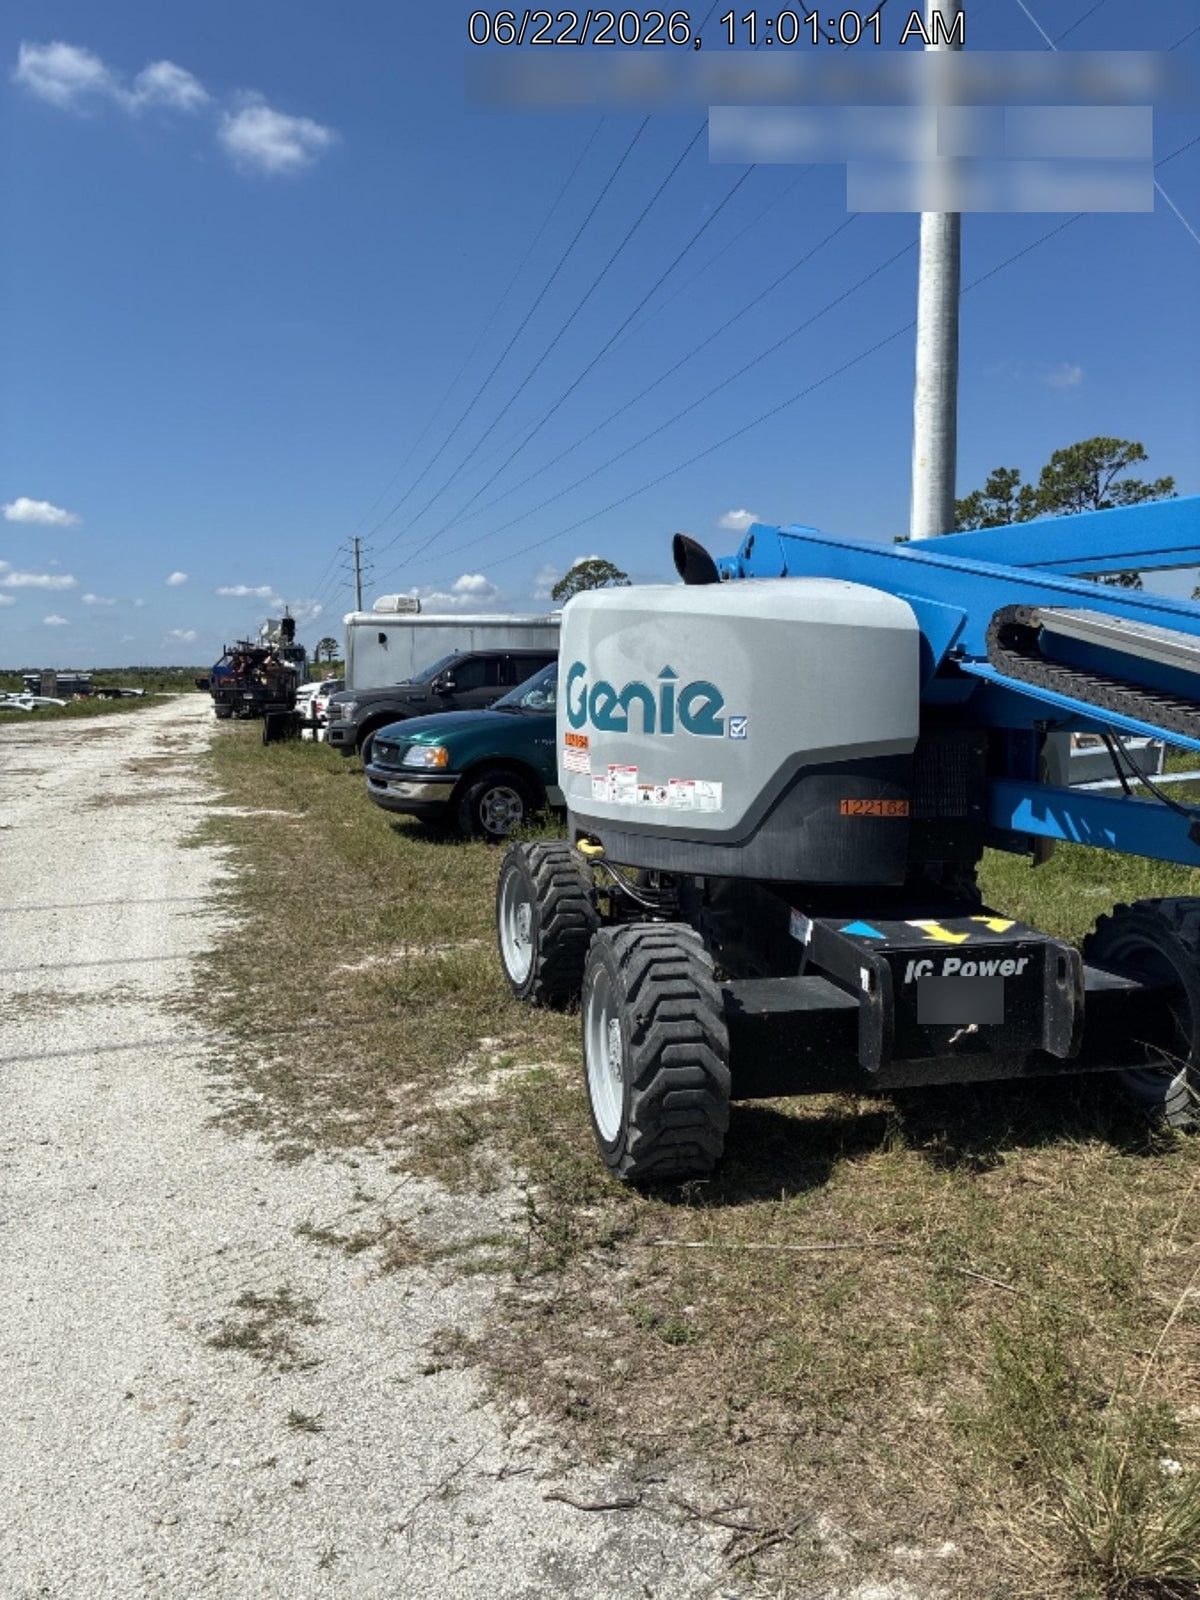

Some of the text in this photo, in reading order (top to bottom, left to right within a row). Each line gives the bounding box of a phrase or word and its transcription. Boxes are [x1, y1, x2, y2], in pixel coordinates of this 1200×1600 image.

[566, 661, 724, 736] Genie
[904, 957, 1029, 983] IC Power
